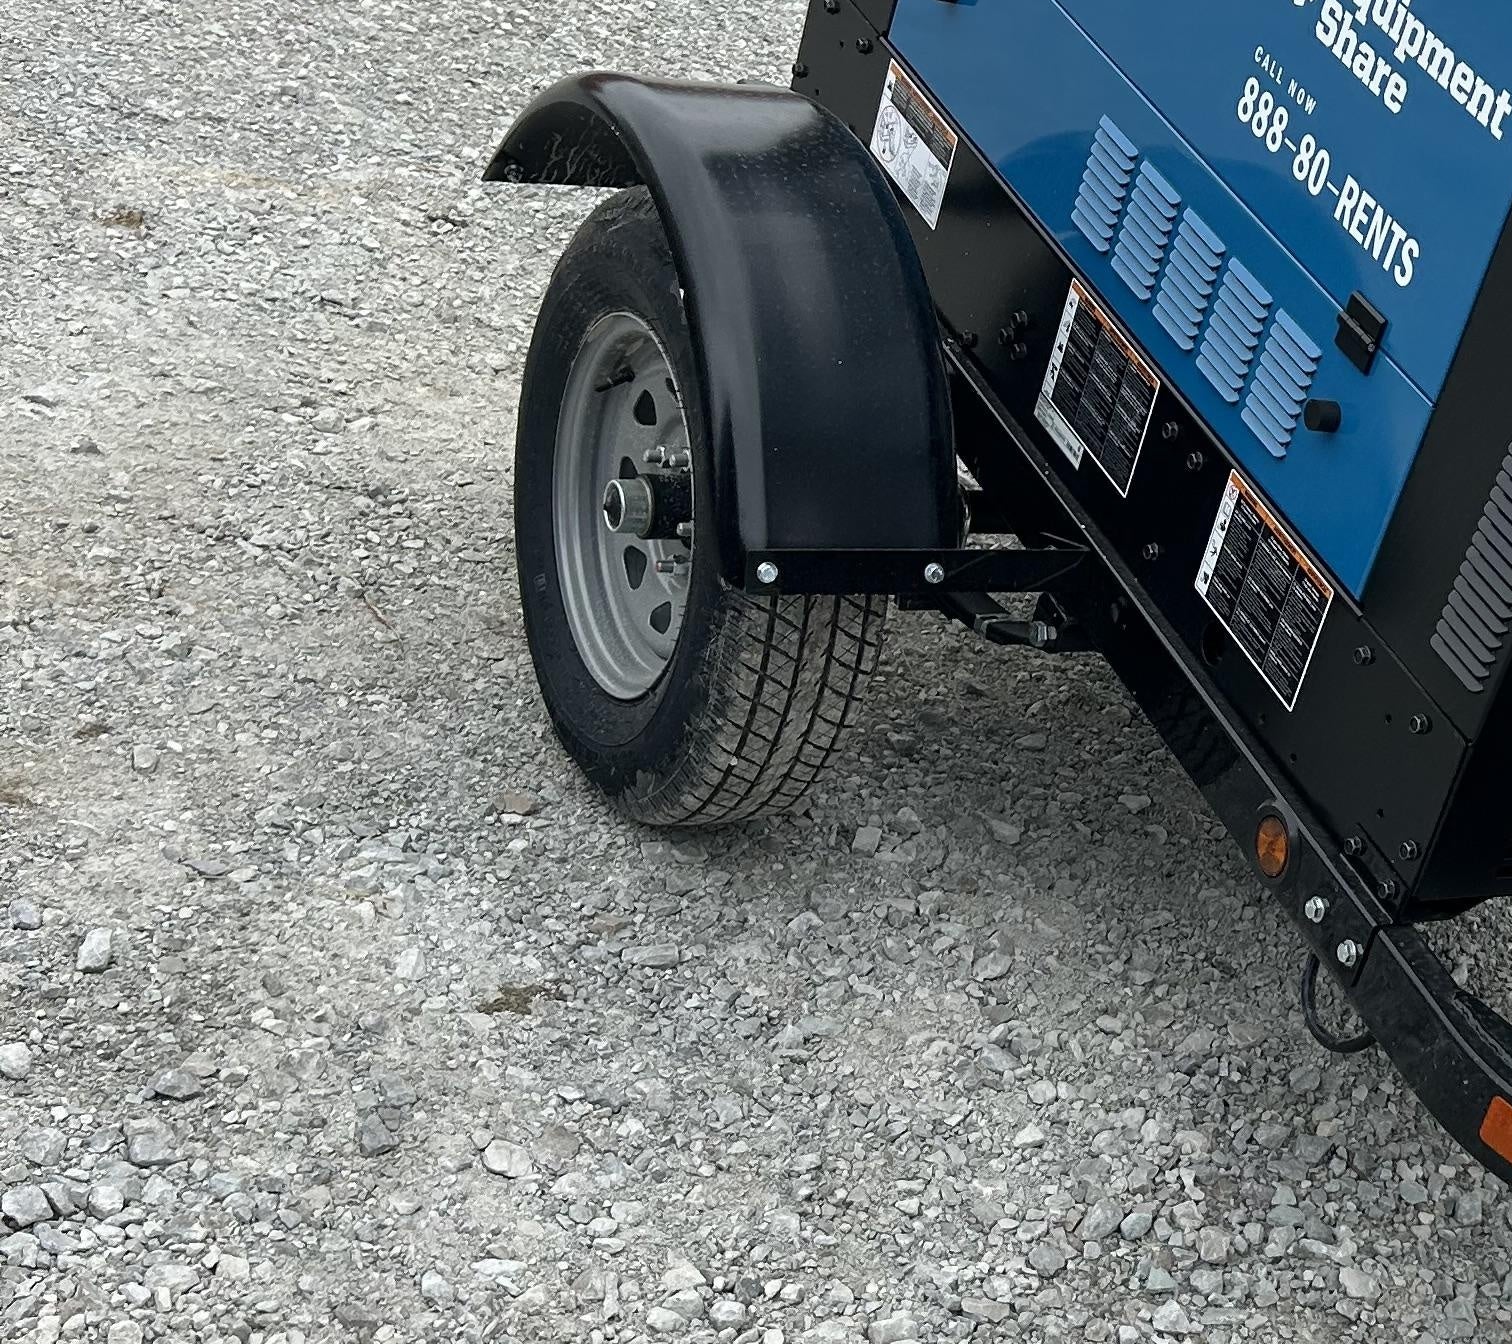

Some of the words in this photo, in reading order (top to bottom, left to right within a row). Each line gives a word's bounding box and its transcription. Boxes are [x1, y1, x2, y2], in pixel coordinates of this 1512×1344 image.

[1254, 45, 1284, 86] CALL
[1287, 78, 1318, 116] NOW
[1236, 76, 1421, 288] 888-80-RENTS
